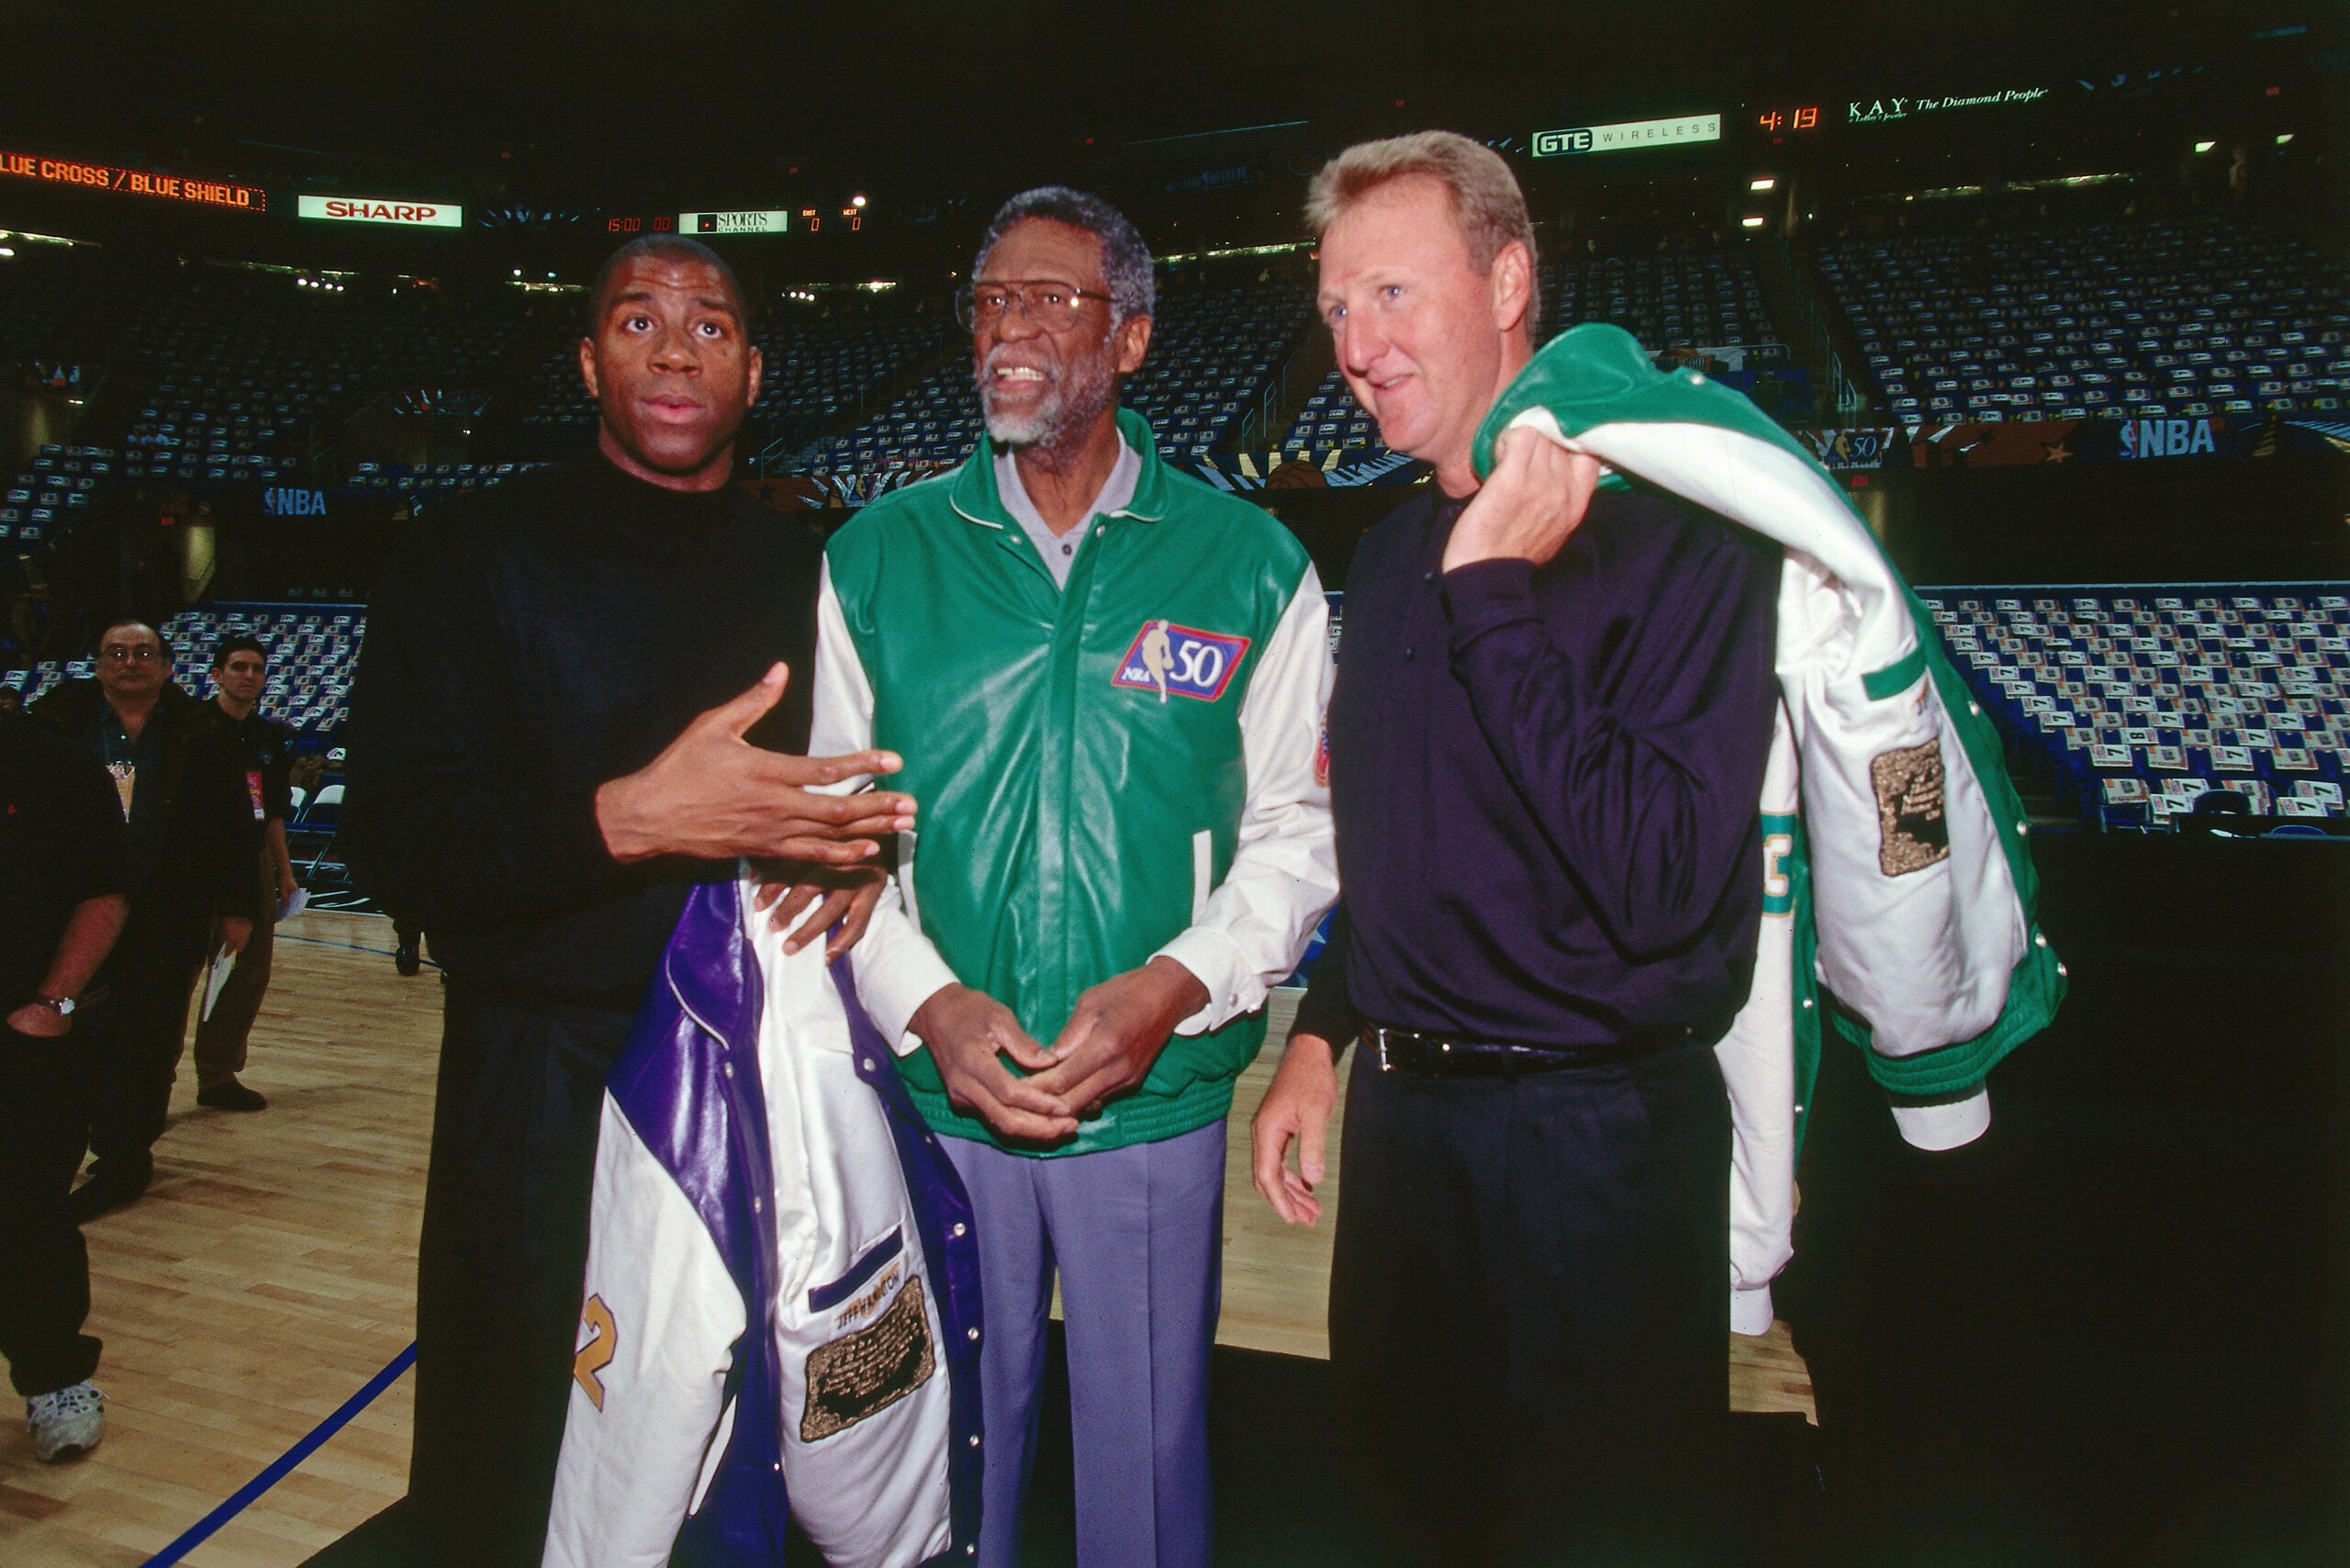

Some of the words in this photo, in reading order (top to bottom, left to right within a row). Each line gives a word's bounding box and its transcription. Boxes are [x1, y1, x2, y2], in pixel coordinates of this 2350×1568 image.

[1849, 96, 1906, 118] KAY
[1917, 98, 1940, 111] The
[1942, 91, 2002, 108] Diamond
[2004, 87, 2045, 103] People
[1539, 131, 1590, 152] GTE
[1602, 122, 1717, 143] WIRELESS
[40, 160, 109, 186] CROSS
[130, 174, 180, 196] BLUE
[184, 181, 250, 207] SHIELD
[325, 200, 437, 222] SHARP
[718, 212, 768, 227] SPORTS
[609, 217, 641, 232] 15:00
[653, 217, 671, 230] 00
[1850, 435, 1877, 458] 50
[2139, 419, 2215, 458] NBA
[277, 487, 327, 515] NBA
[1121, 666, 1151, 683] NBA
[1169, 639, 1224, 689] 50
